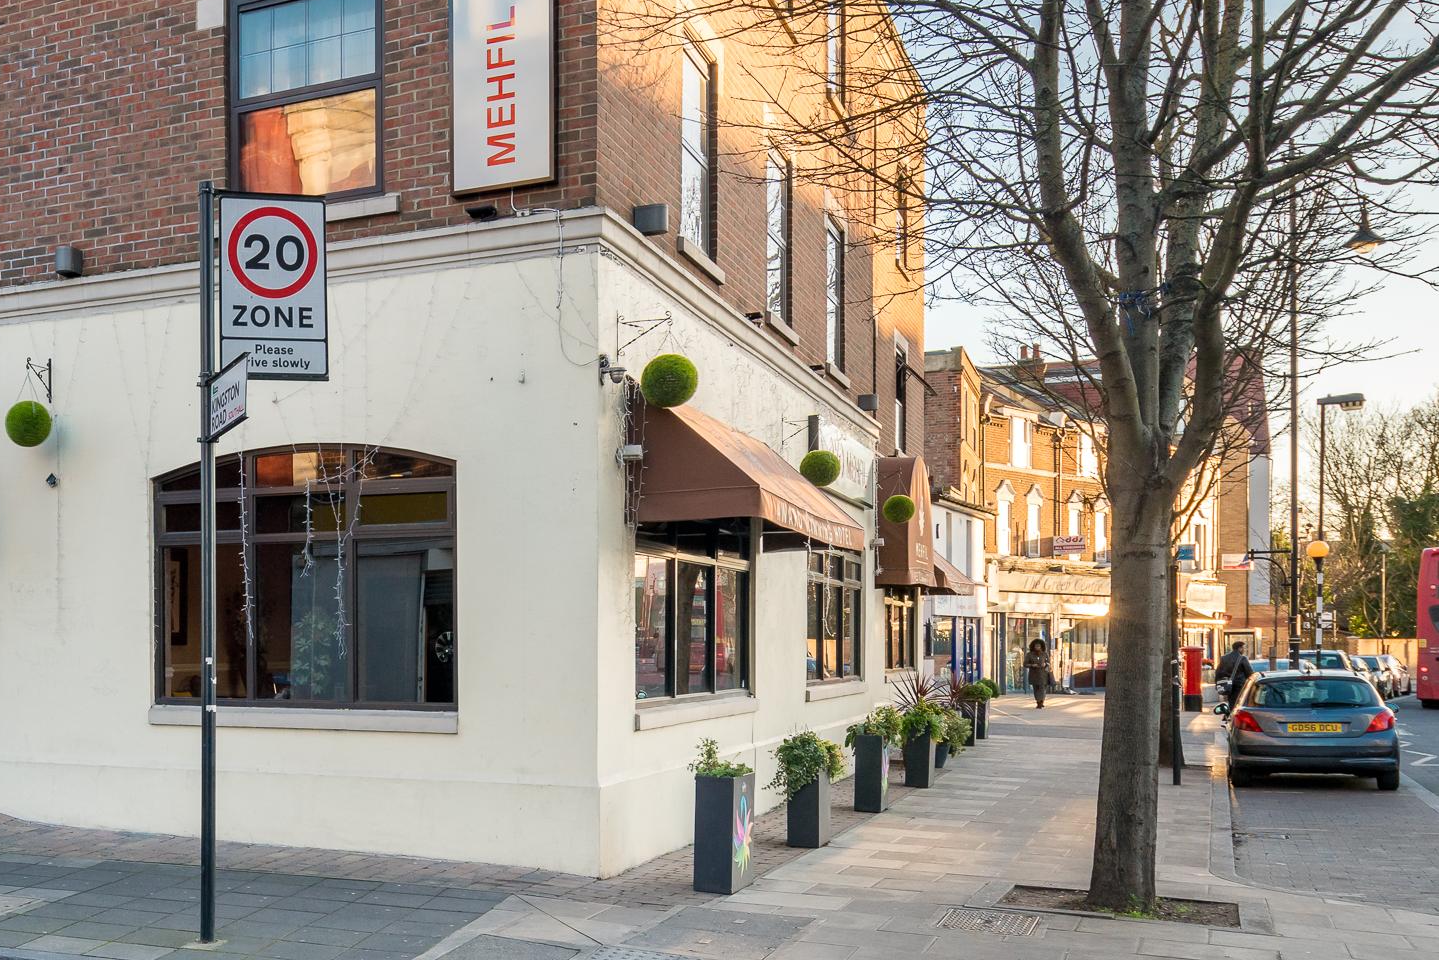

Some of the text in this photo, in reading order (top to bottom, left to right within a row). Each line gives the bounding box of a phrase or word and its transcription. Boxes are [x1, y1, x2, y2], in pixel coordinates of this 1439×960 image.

[486, 5, 516, 167] MEHFIL
[244, 233, 305, 272] 20
[232, 304, 314, 329] ZONE
[255, 344, 294, 355] Please
[247, 357, 311, 370] ive slowly
[211, 381, 240, 415] KINGSTON
[211, 409, 227, 433] ROAD
